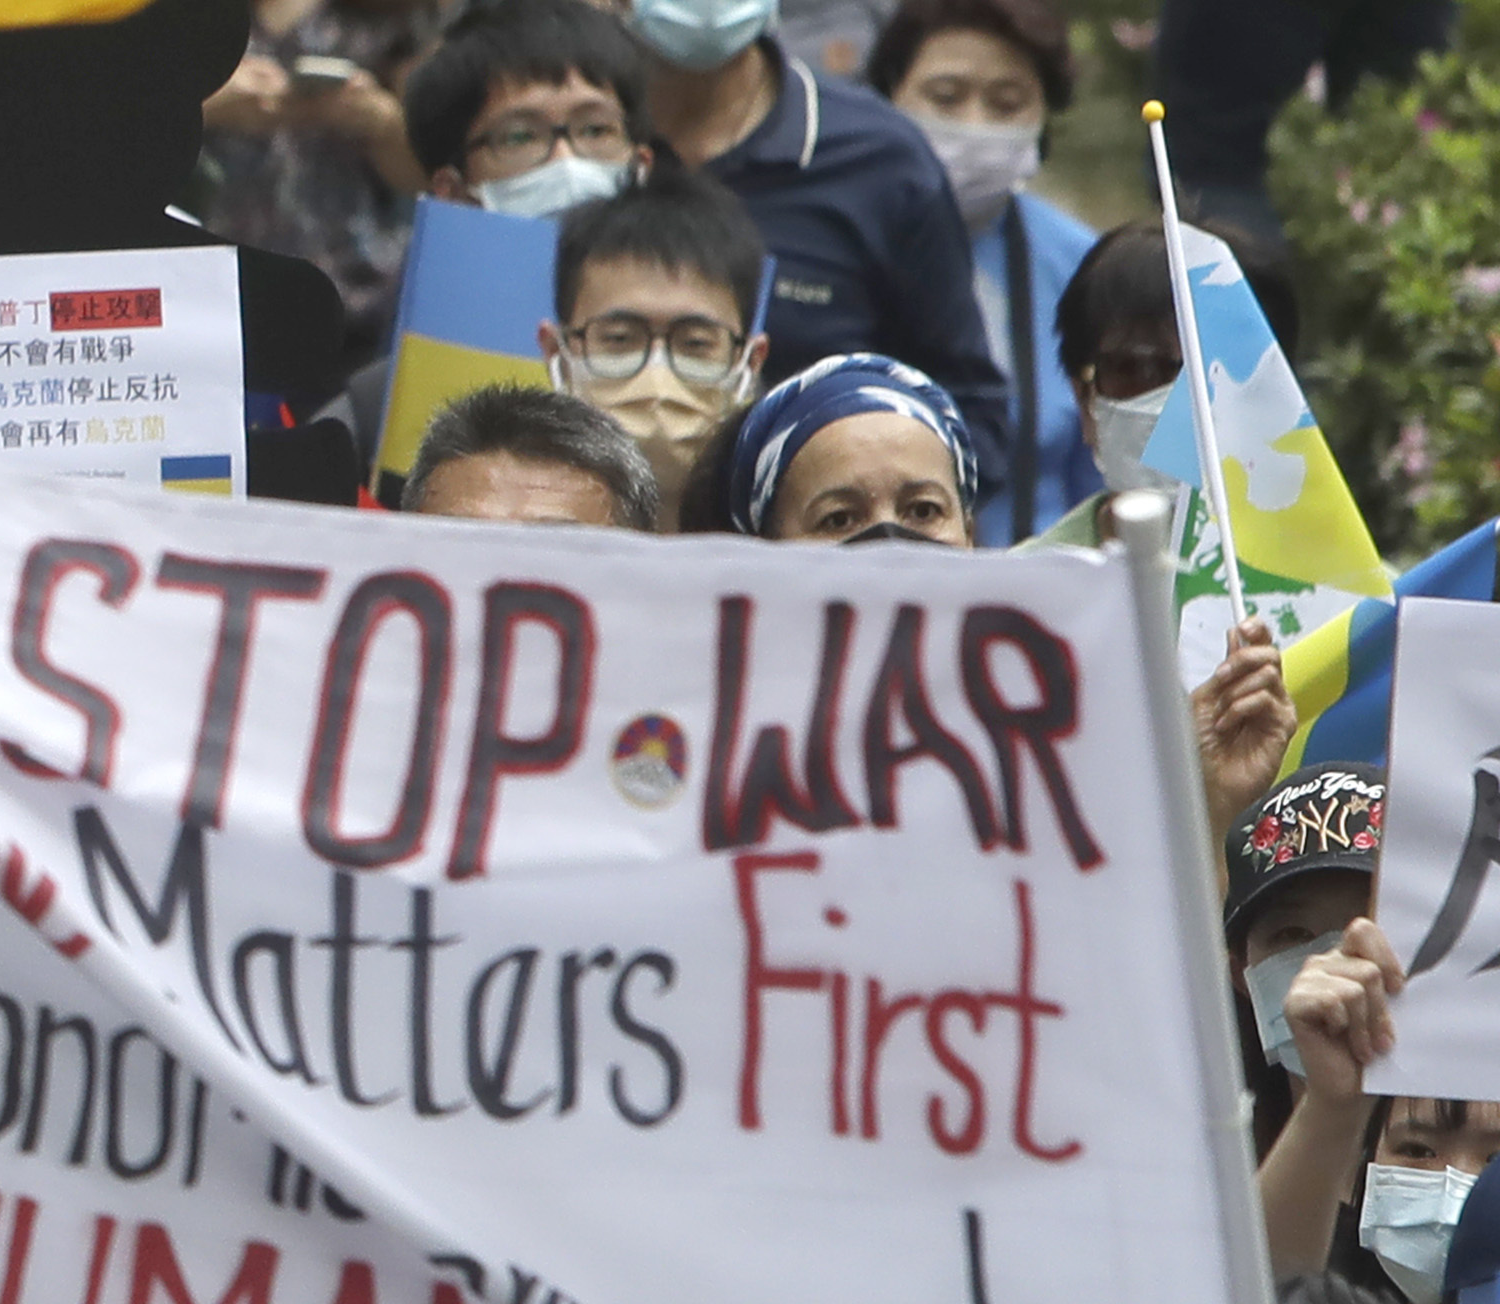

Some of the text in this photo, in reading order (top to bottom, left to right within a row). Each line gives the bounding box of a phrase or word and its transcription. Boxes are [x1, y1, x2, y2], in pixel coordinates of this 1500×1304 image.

[702, 594, 1107, 870] WAR
[1262, 778, 1321, 815] New
[75, 804, 688, 1130] Matters
[733, 852, 1085, 1164] First
